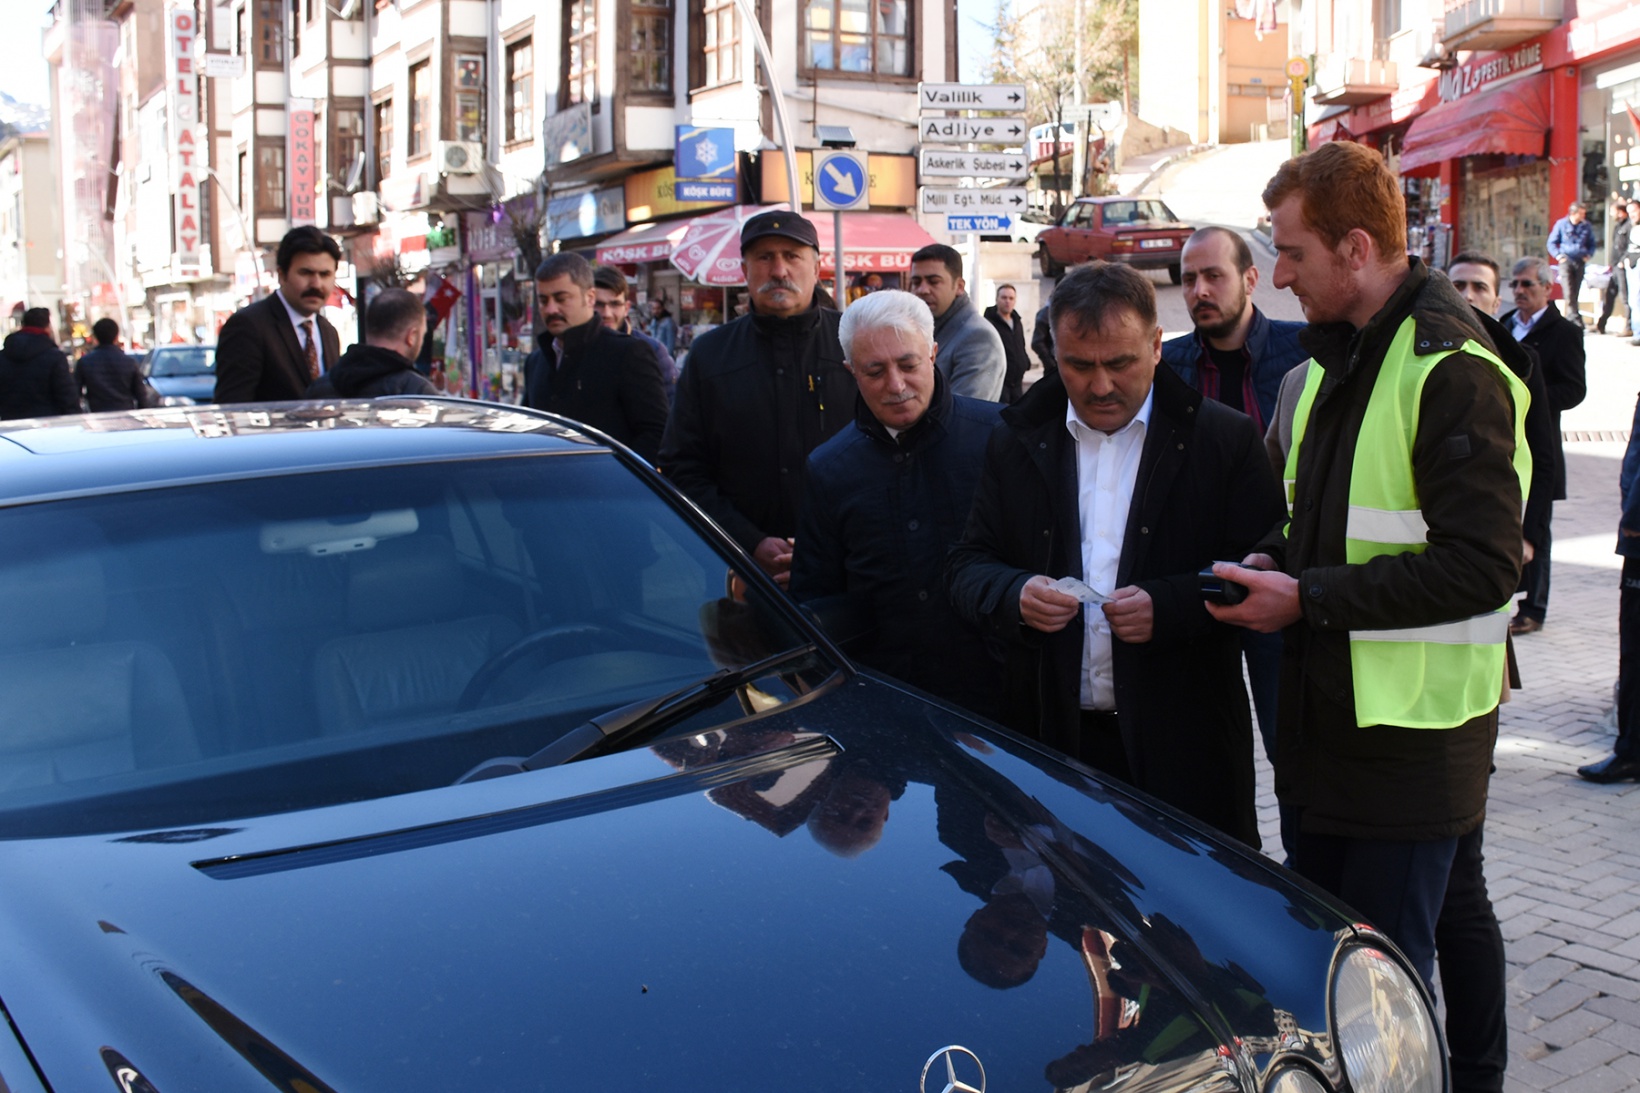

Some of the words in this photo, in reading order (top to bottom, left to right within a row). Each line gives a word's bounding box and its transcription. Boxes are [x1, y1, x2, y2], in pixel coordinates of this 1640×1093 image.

[175, 15, 192, 95] OTEL
[925, 90, 983, 103] Valilik
[926, 122, 994, 139] Adliye
[927, 157, 966, 169] Askerlik
[973, 157, 1006, 171] Şubesi
[178, 129, 197, 252] ATALAY
[683, 186, 707, 199] KÖŞK
[709, 186, 733, 198] BÜFE
[950, 217, 973, 230] TEK
[974, 215, 999, 230] YÖN
[602, 247, 648, 262] KÖŞK
[880, 253, 911, 267] BÜ
[1625, 578, 1640, 589] ZA
